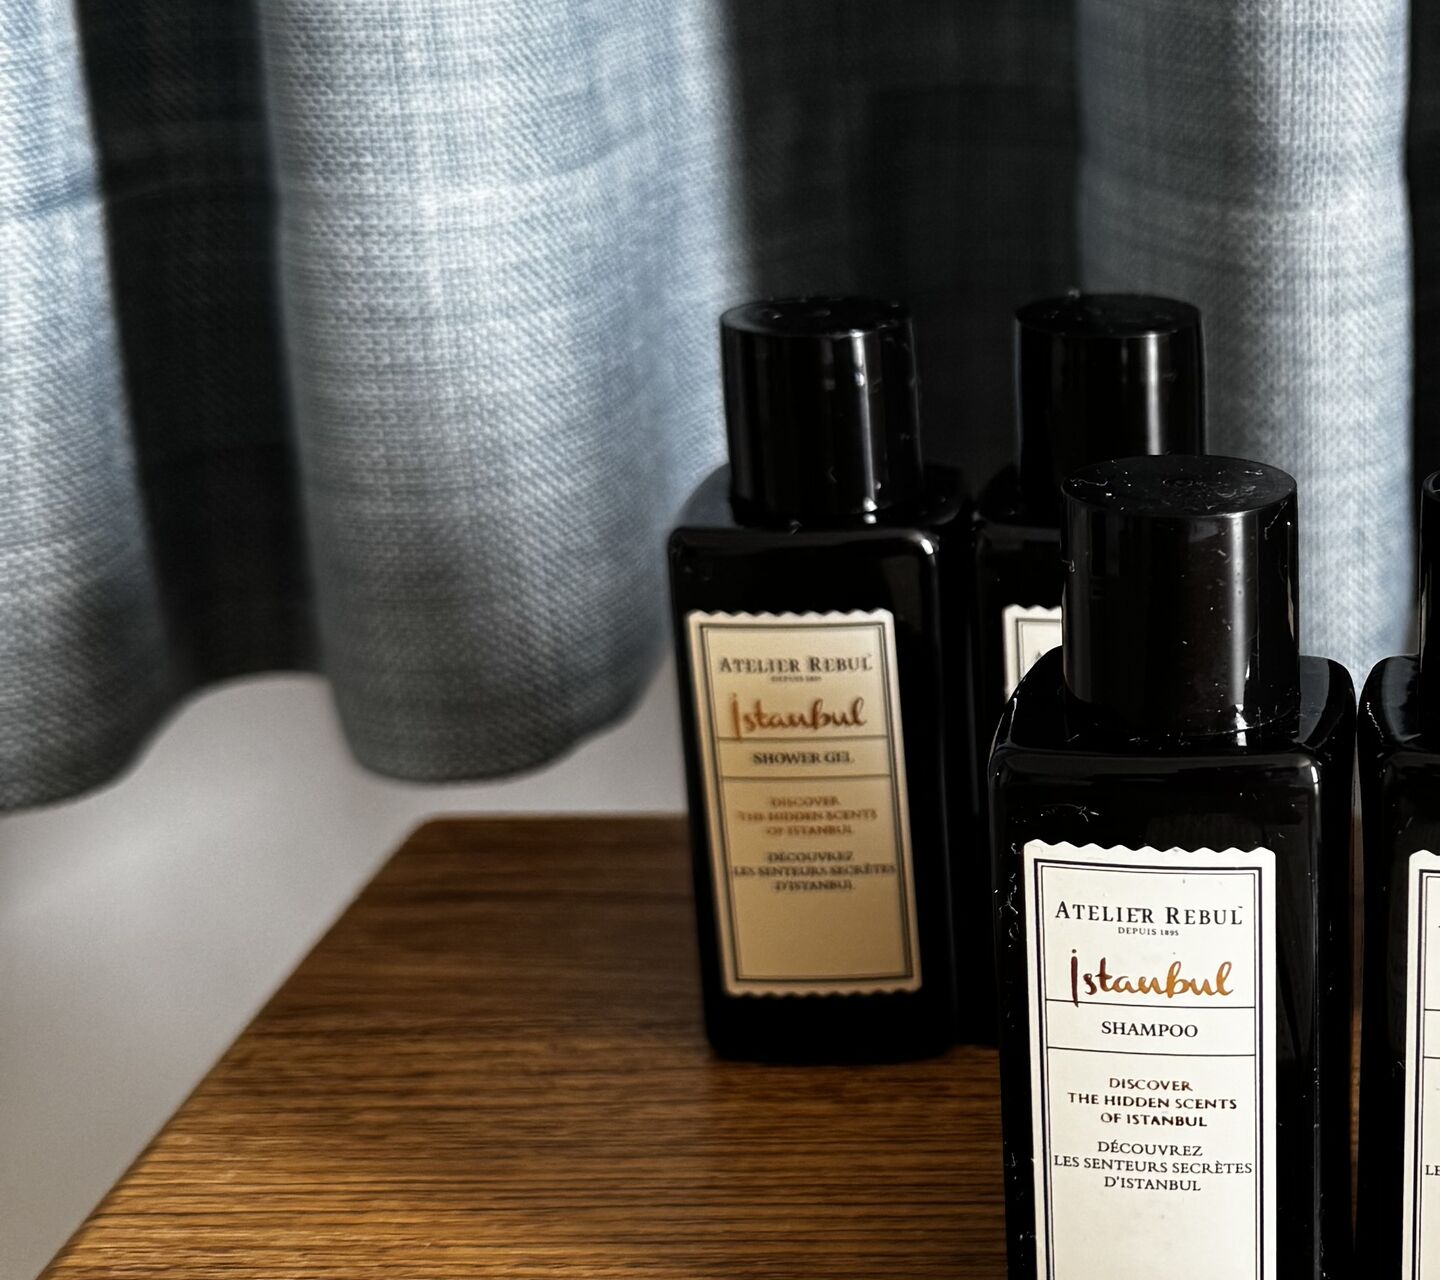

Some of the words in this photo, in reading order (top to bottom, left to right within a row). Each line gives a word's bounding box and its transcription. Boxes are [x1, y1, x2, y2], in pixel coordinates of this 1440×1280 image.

[720, 656, 800, 673] ATELIER
[808, 655, 873, 671] REBUL
[752, 751, 821, 765] SHOWER
[824, 749, 855, 764] GEL
[1055, 900, 1155, 924] ATELIER
[1165, 906, 1243, 925] REBUL
[1117, 925, 1157, 936] DEPUIS
[1101, 1020, 1199, 1038] SHAMPOO
[1109, 1076, 1193, 1091] DISCOVER
[1067, 1092, 1100, 1105] THE
[1104, 1094, 1170, 1109] HIDDEN
[1175, 1097, 1238, 1110] SCENTS
[1100, 1112, 1122, 1124] OF
[1126, 1114, 1208, 1127] ISTANBUL
[1098, 1138, 1203, 1157] DÉCOUVREZ
[1053, 1154, 1080, 1168] LES
[1084, 1157, 1168, 1173] SENTEURS
[1171, 1159, 1253, 1175] SECRÈTES
[1103, 1175, 1202, 1192] D'ISTANBUL
